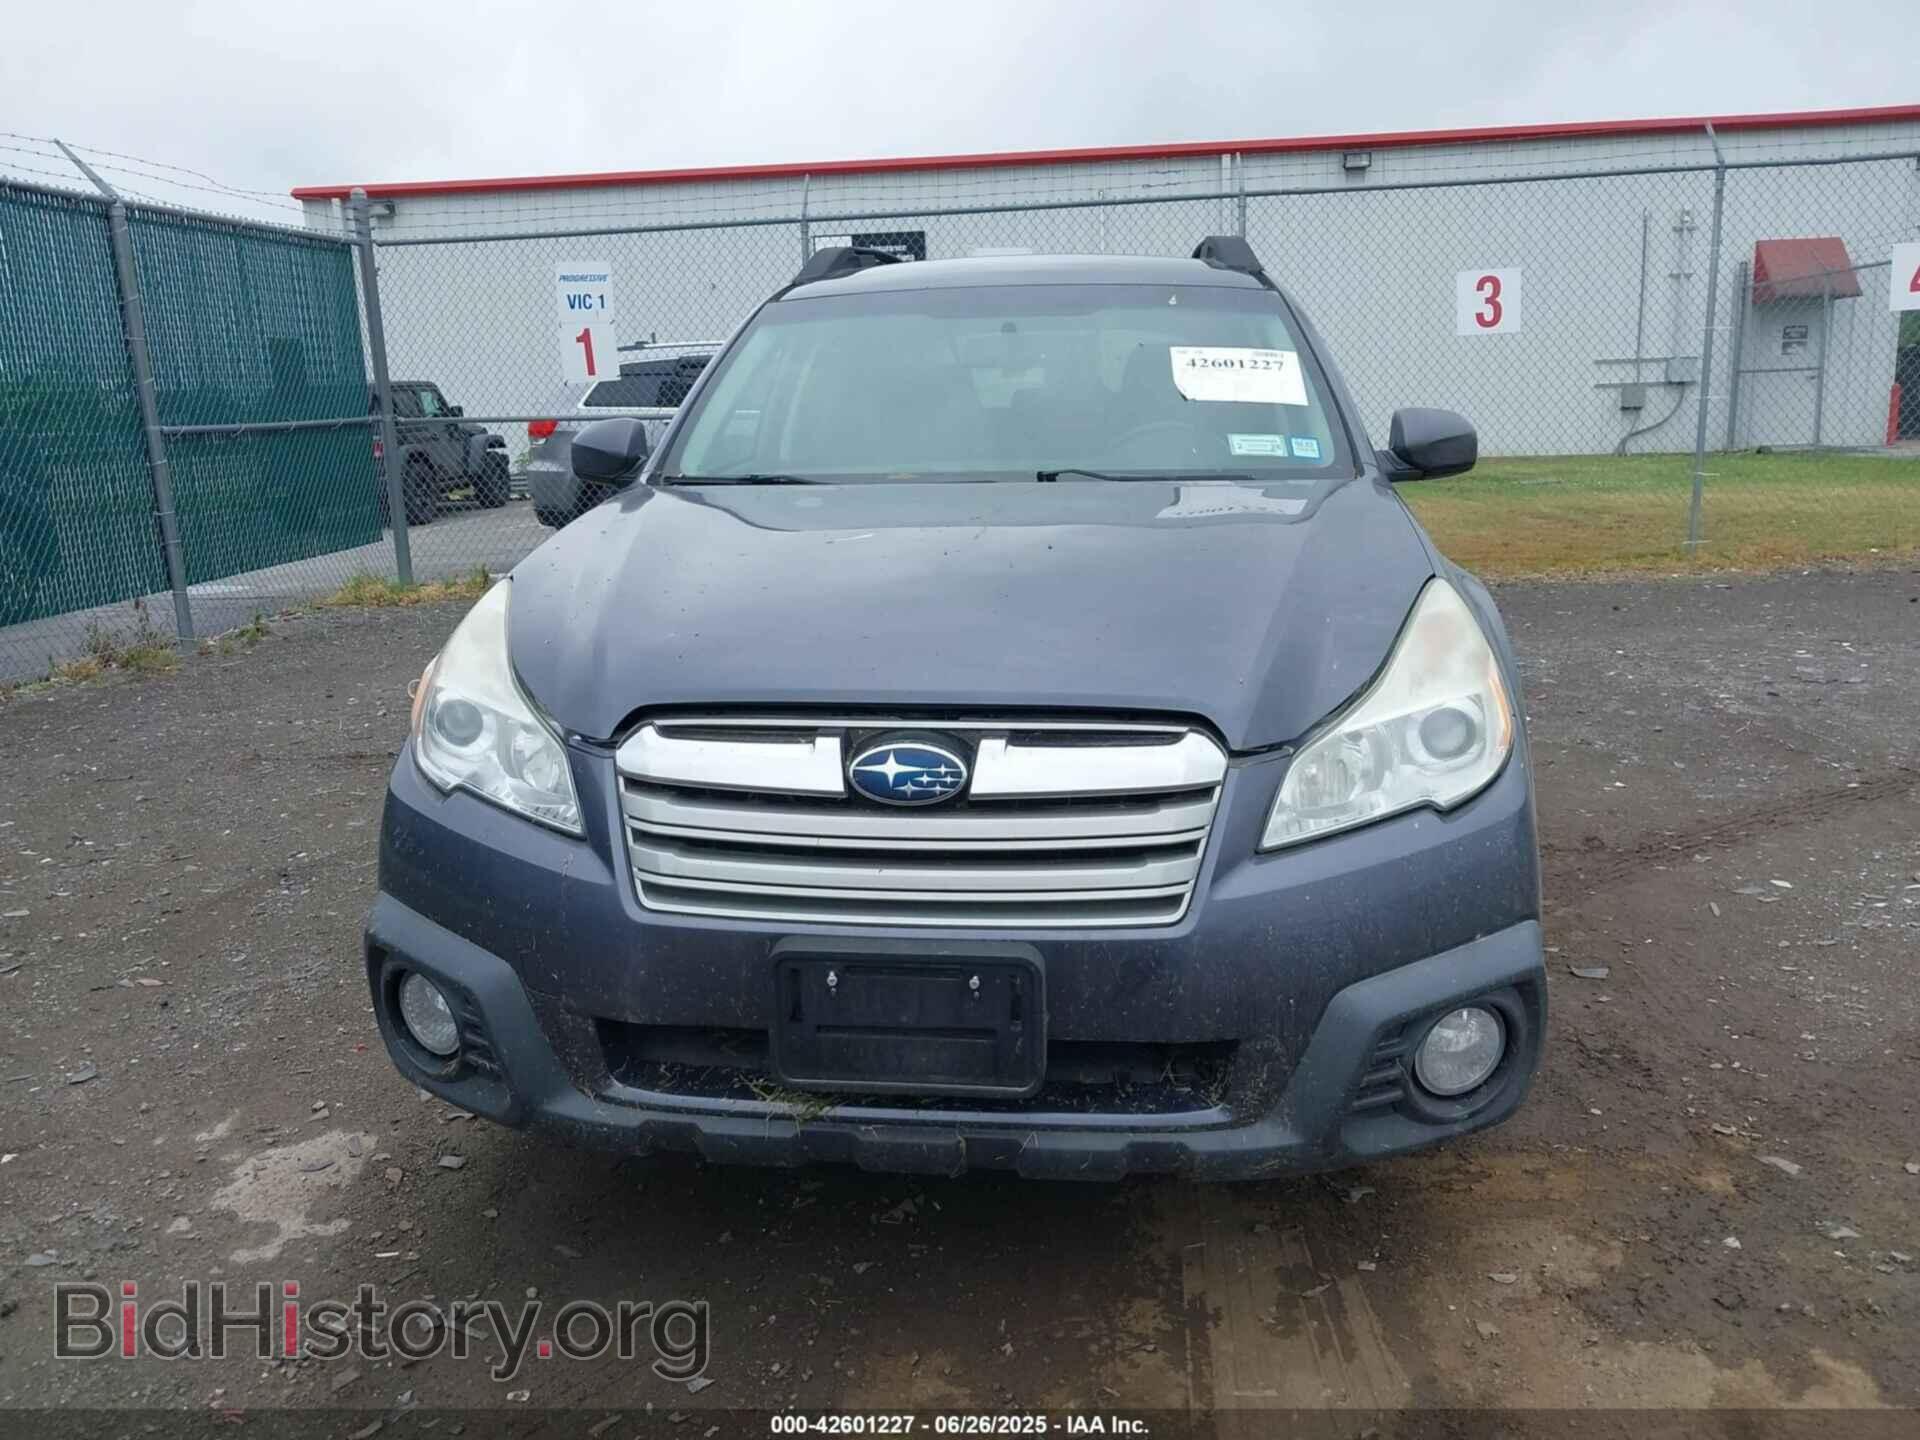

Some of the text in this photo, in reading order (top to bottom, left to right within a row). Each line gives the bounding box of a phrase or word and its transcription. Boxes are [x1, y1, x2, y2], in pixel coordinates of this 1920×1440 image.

[566, 293, 605, 310] VIC 1
[1476, 275, 1502, 328] 3
[575, 327, 596, 376] 1
[1186, 358, 1284, 371] 42601227
